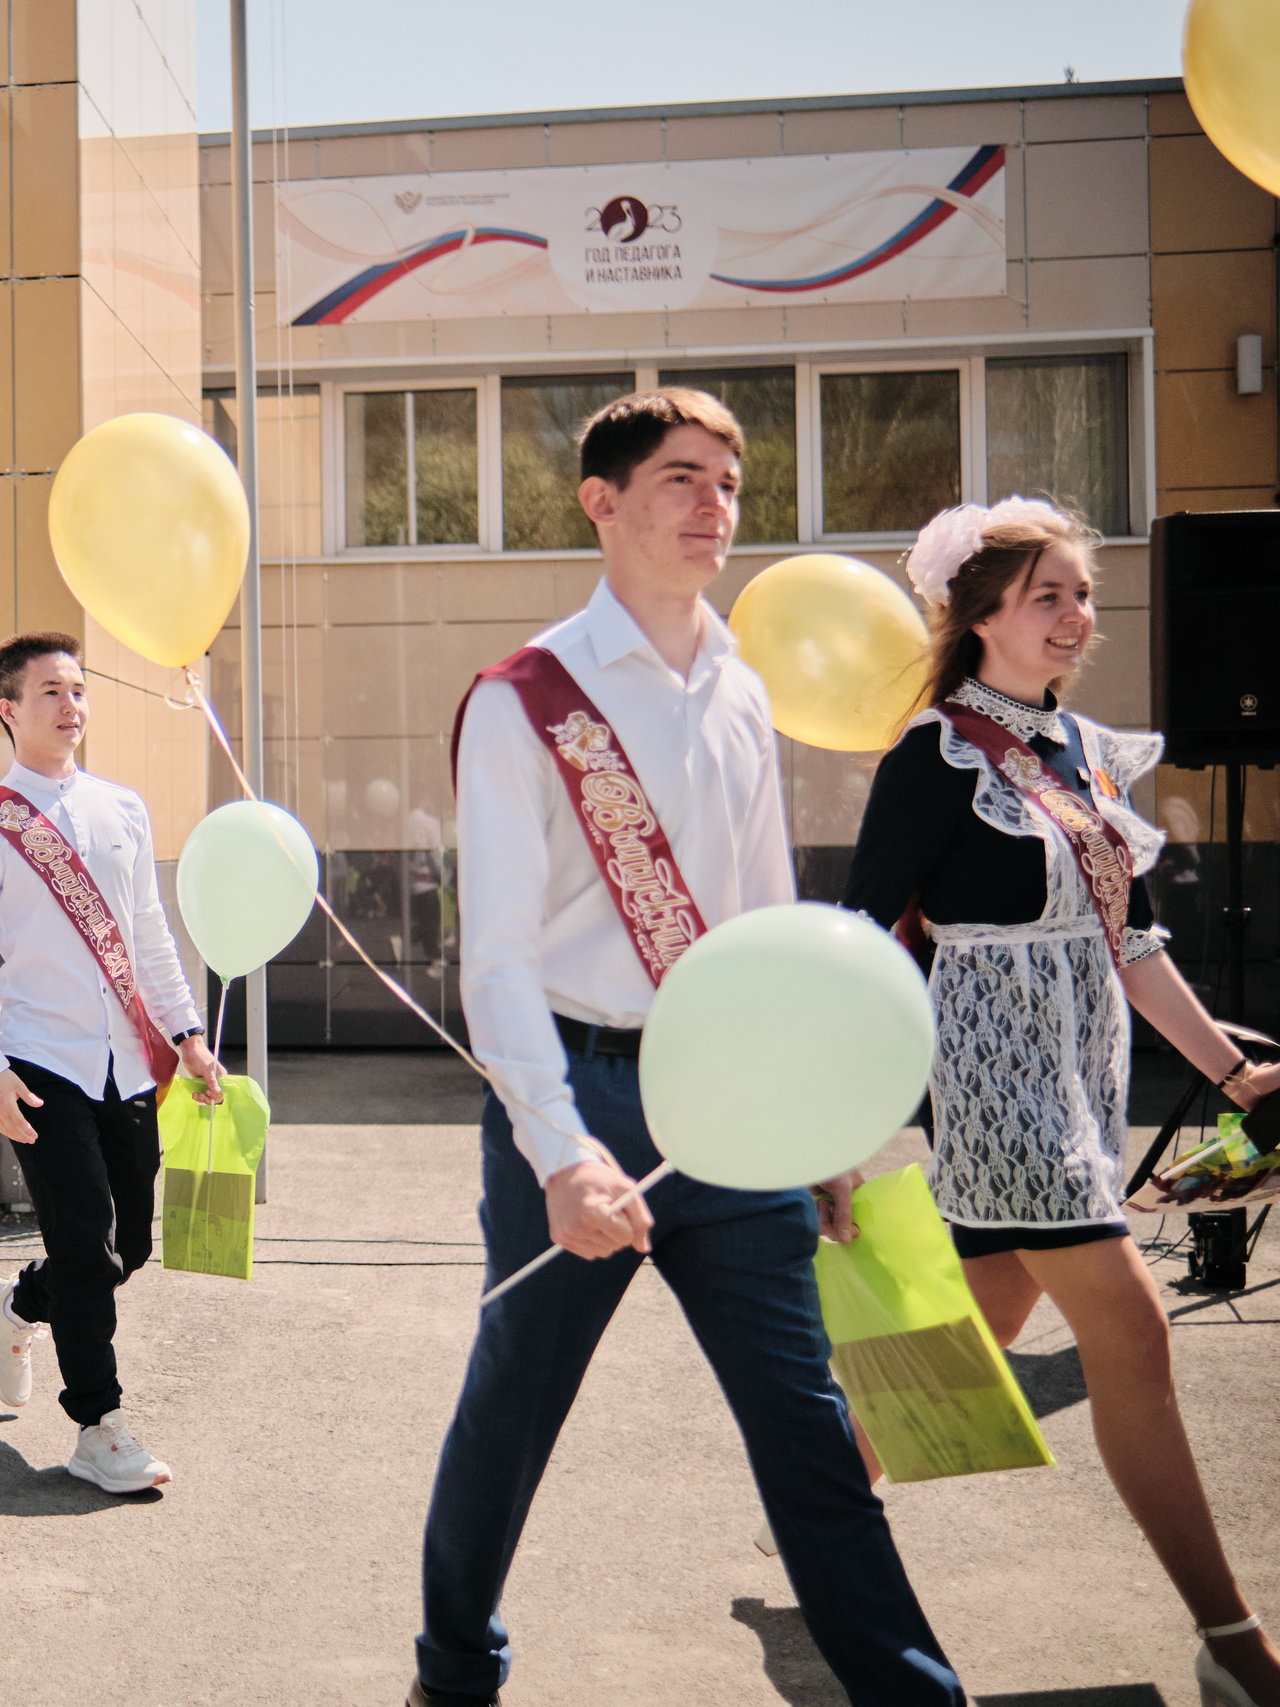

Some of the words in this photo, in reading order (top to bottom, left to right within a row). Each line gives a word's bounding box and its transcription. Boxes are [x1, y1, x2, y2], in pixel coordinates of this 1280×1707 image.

[584, 246, 611, 264] ГОД
[615, 244, 682, 263] ПЕДАГОГА
[585, 268, 595, 284] И
[597, 265, 683, 283] НАСТАВНИКА
[21, 827, 116, 954] Выпускник
